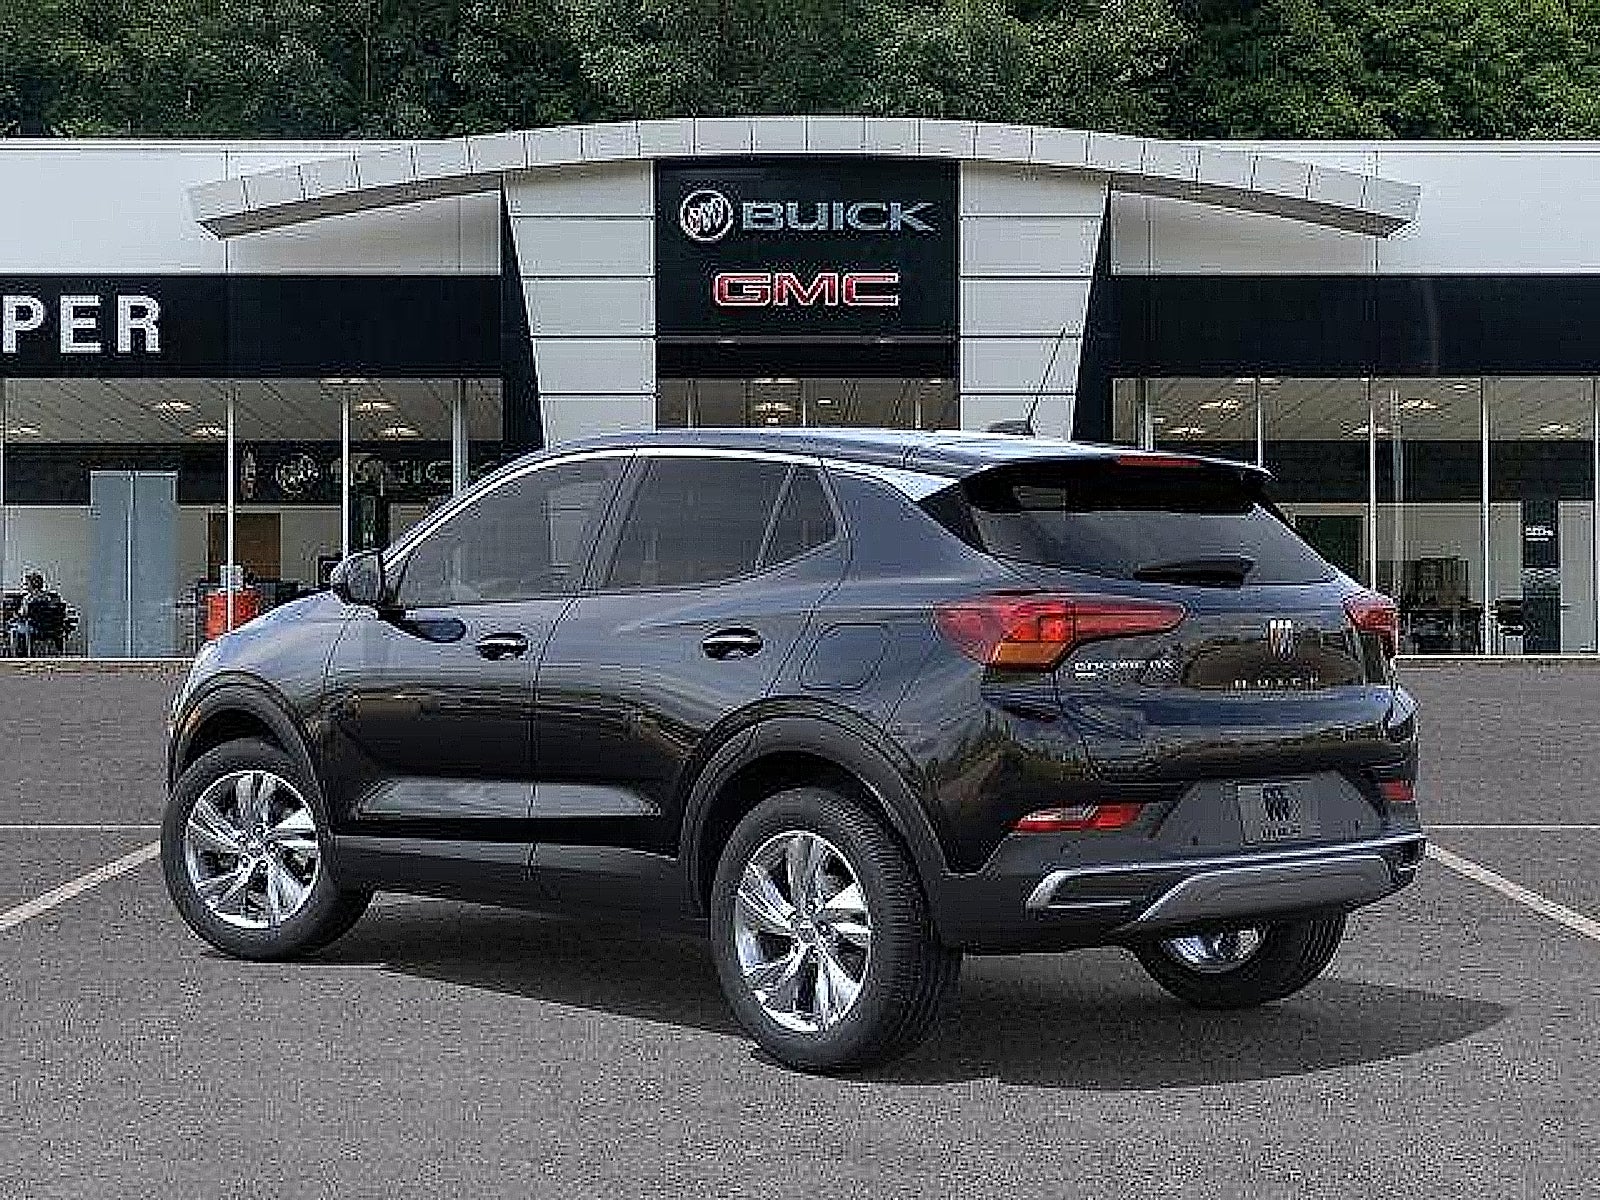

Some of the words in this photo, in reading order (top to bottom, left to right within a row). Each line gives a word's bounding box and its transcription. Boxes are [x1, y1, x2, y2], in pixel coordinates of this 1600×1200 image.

[741, 202, 935, 231] BUICK
[713, 272, 899, 307] GMC
[2, 294, 161, 353] PER
